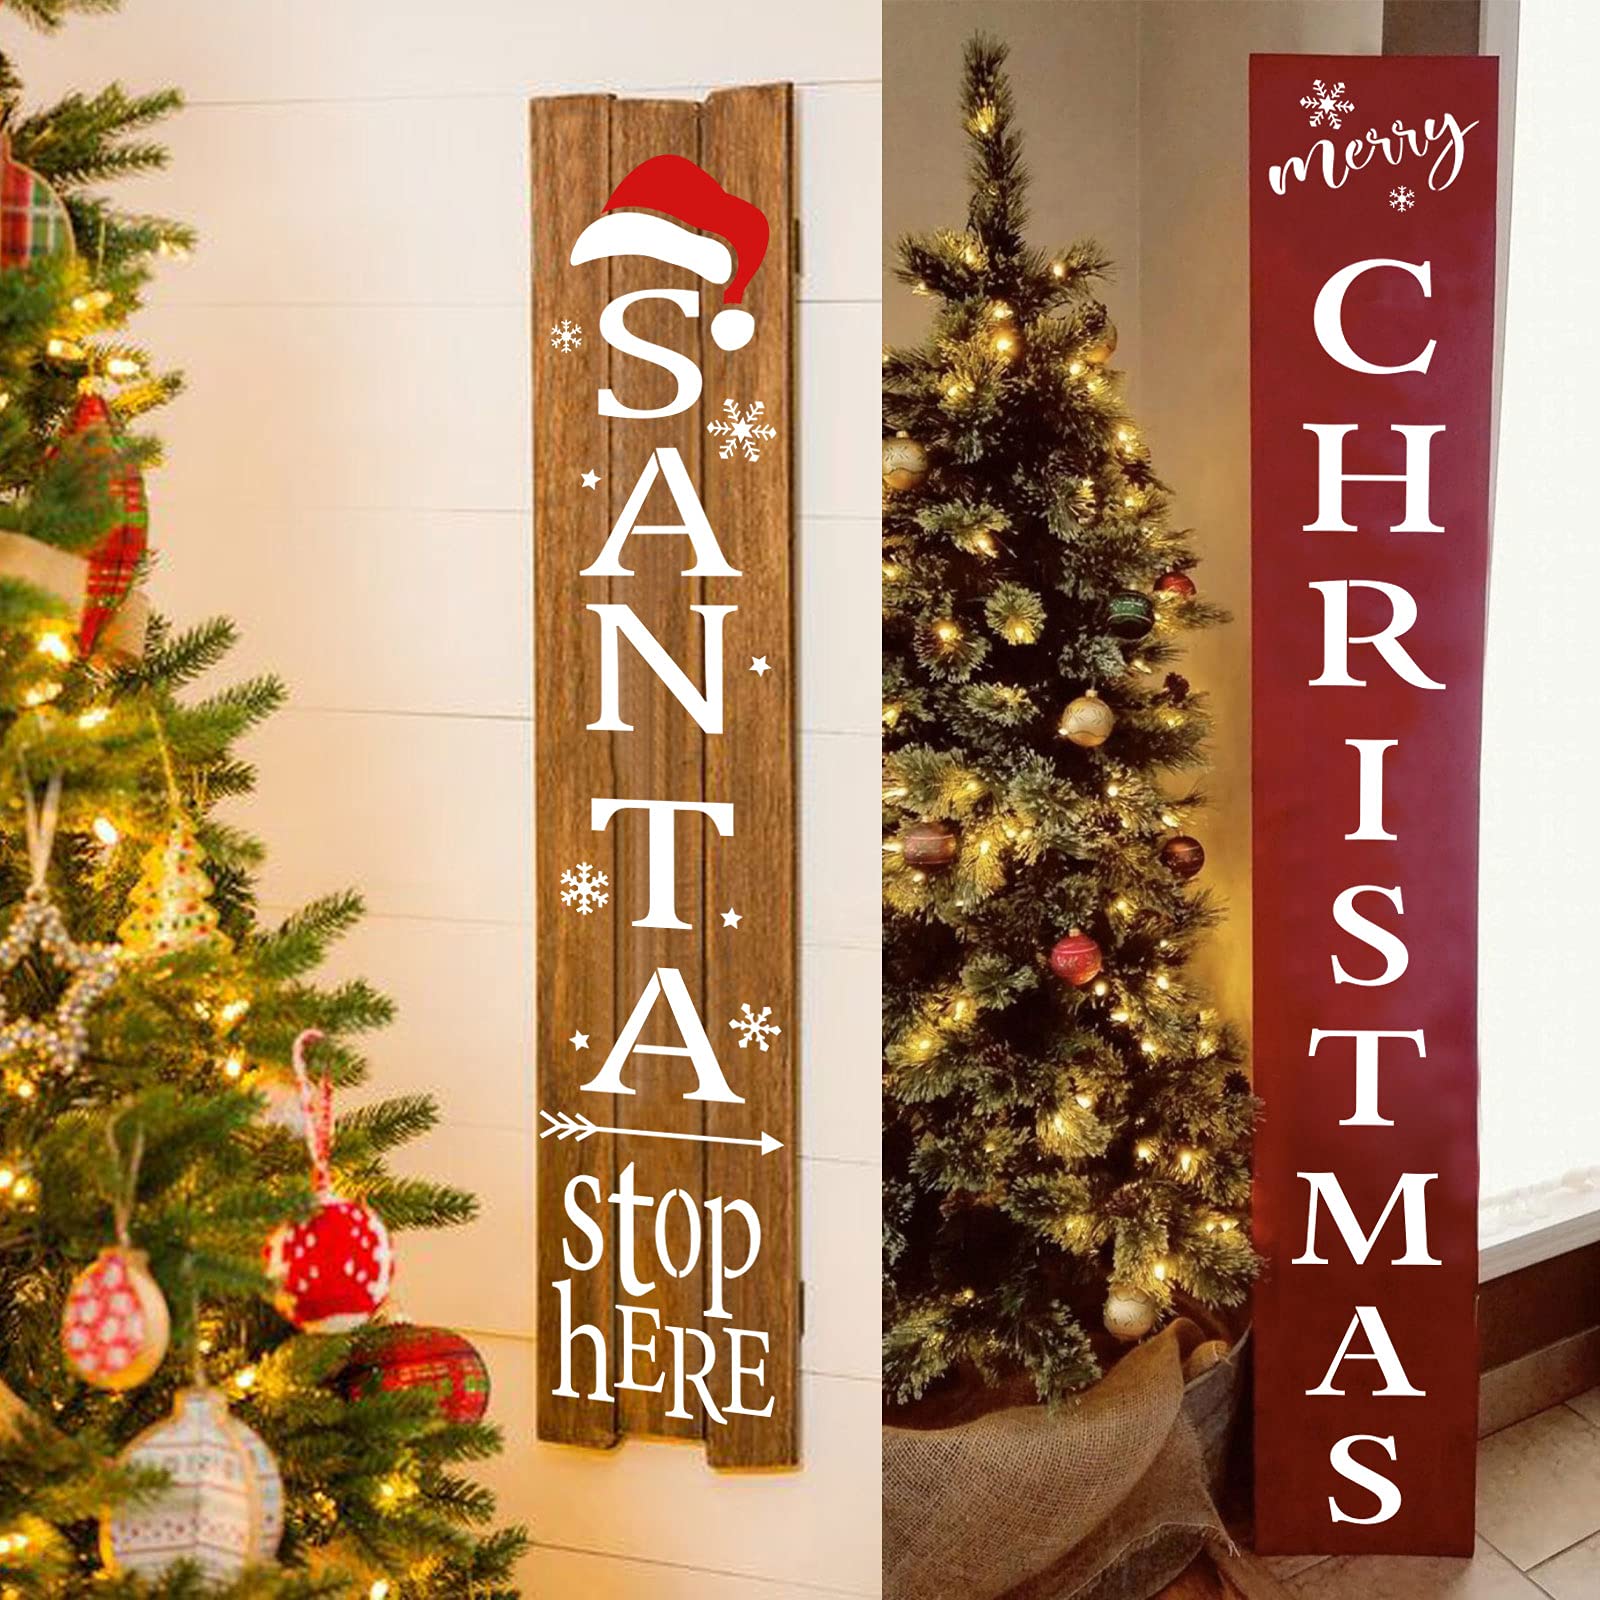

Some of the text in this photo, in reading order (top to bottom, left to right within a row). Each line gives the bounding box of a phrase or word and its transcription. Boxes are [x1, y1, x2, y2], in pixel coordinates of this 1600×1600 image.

[1268, 112, 1479, 196] merry
[579, 287, 745, 1104] SANTA
[1291, 258, 1446, 1526] CHRISTMAS
[562, 1162, 762, 1320] stop
